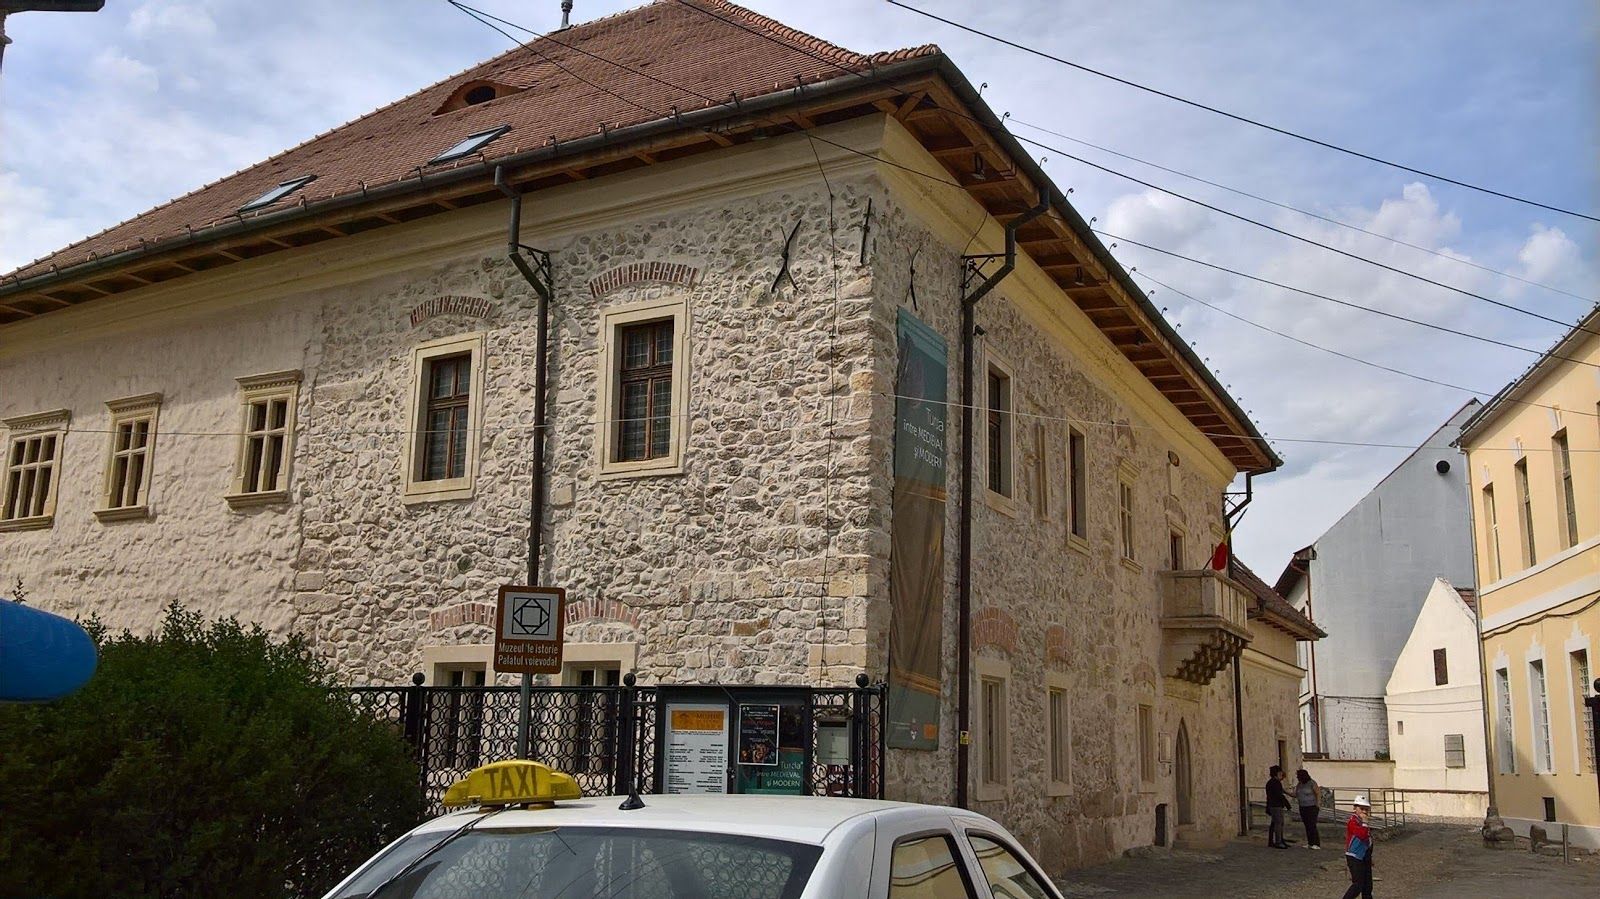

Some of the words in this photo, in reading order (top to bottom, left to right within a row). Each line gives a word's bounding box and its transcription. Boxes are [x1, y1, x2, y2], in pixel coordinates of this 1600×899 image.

[925, 406, 944, 432] Tua
[499, 642, 524, 653] Muzeul
[535, 643, 559, 655] istorie
[498, 654, 524, 665] Palatul
[483, 764, 539, 799] TAXI
[772, 779, 801, 788] MODERN
